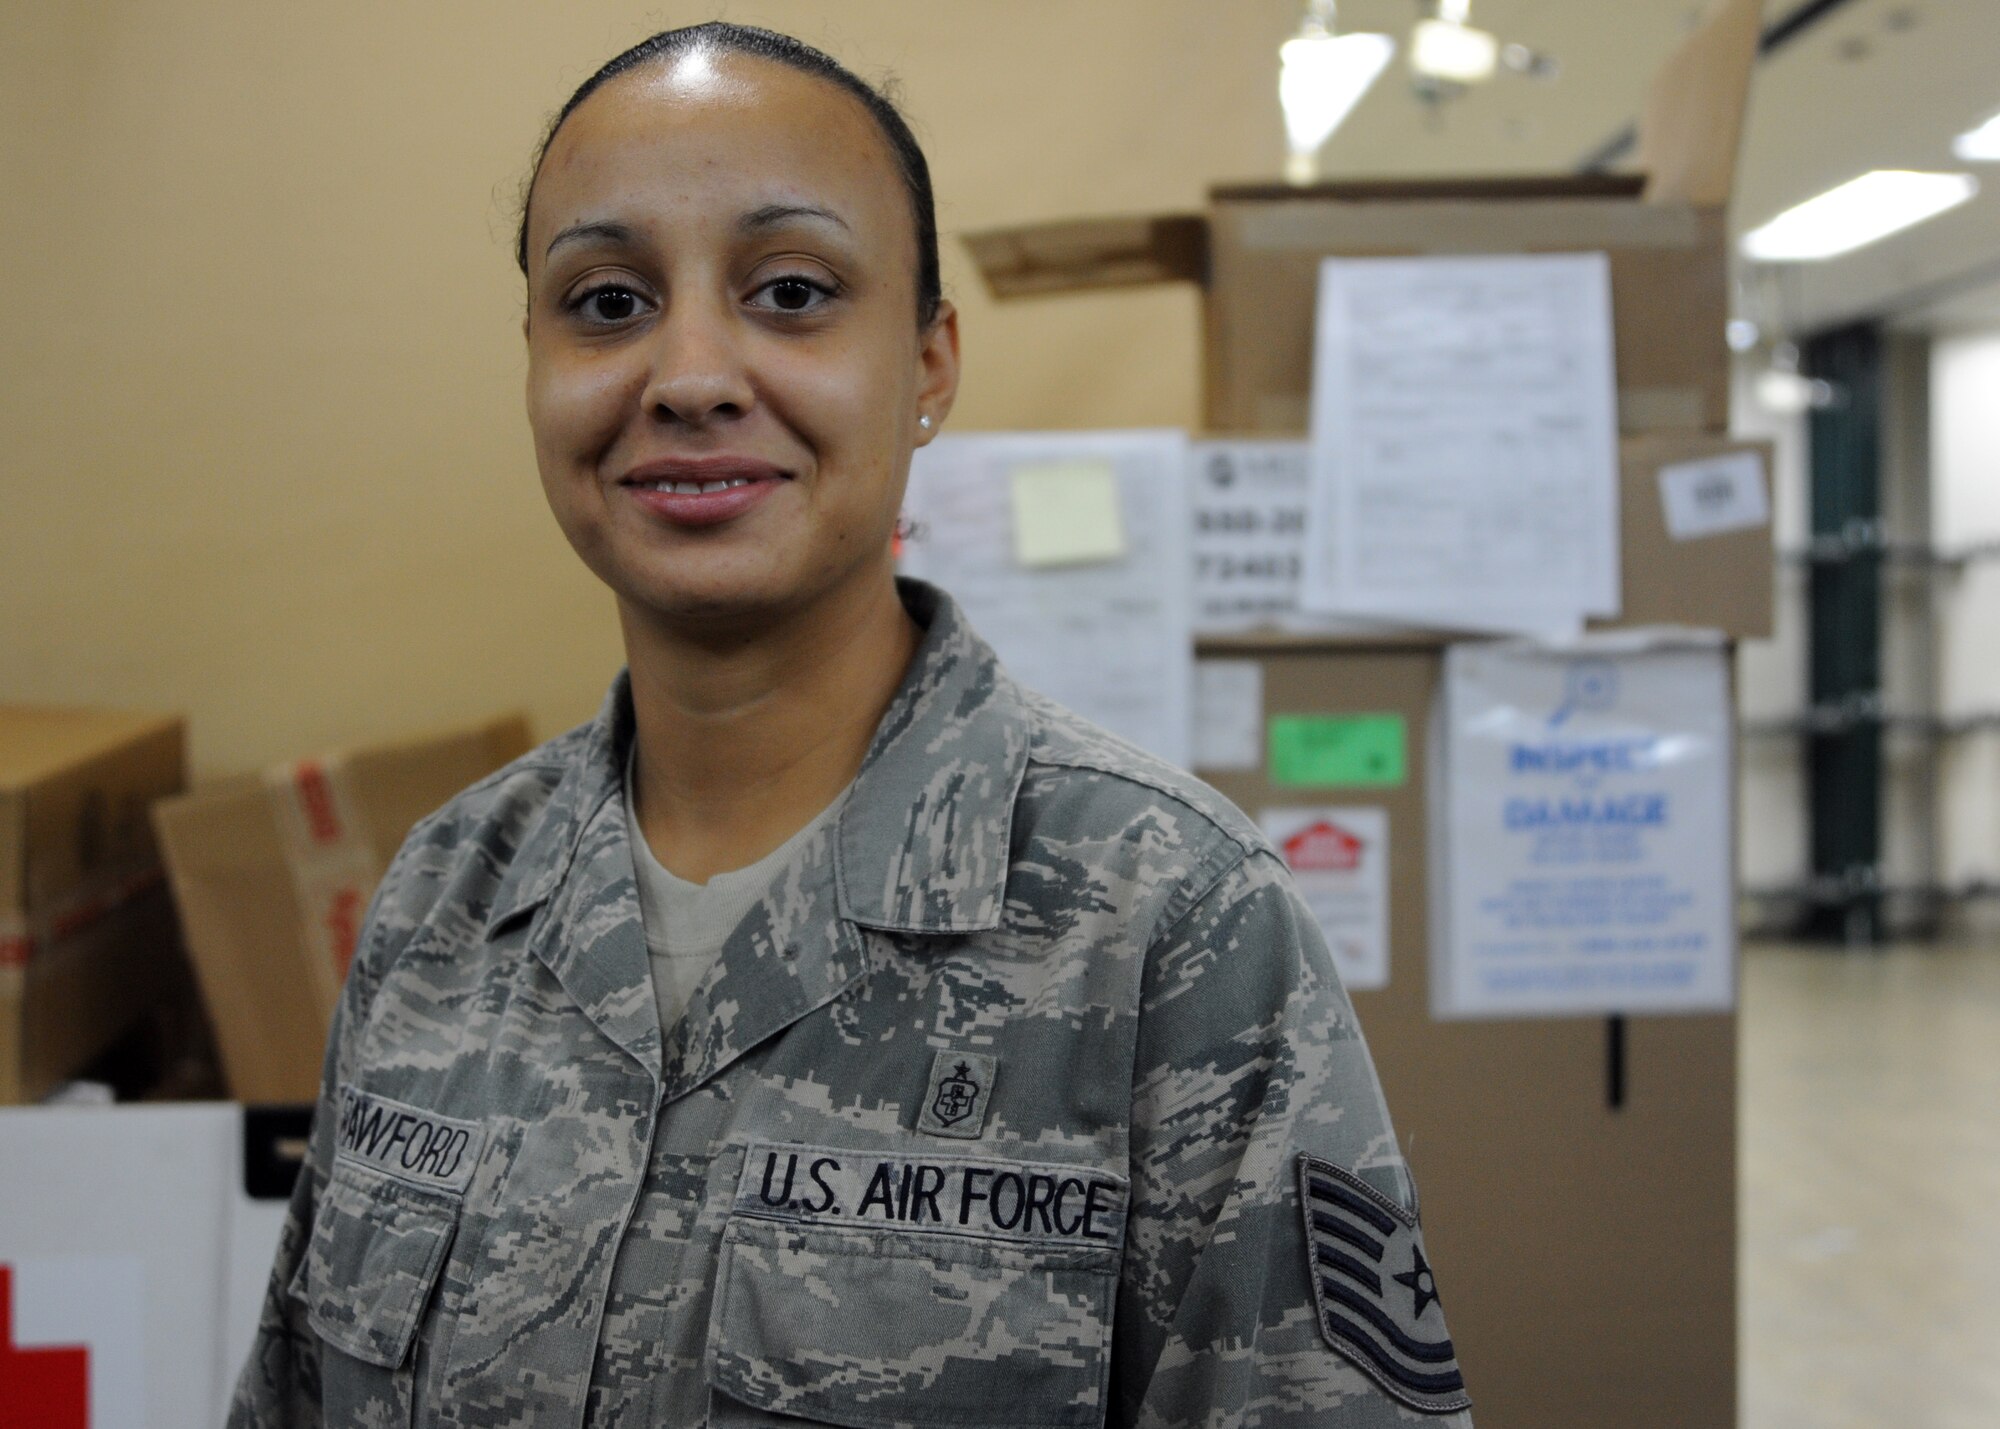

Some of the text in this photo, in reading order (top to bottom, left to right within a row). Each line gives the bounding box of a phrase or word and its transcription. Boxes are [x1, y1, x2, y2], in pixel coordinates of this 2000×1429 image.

[1504, 797, 1668, 829] DAMAGE
[759, 1152, 1118, 1240] U.S. AIR FORCE
